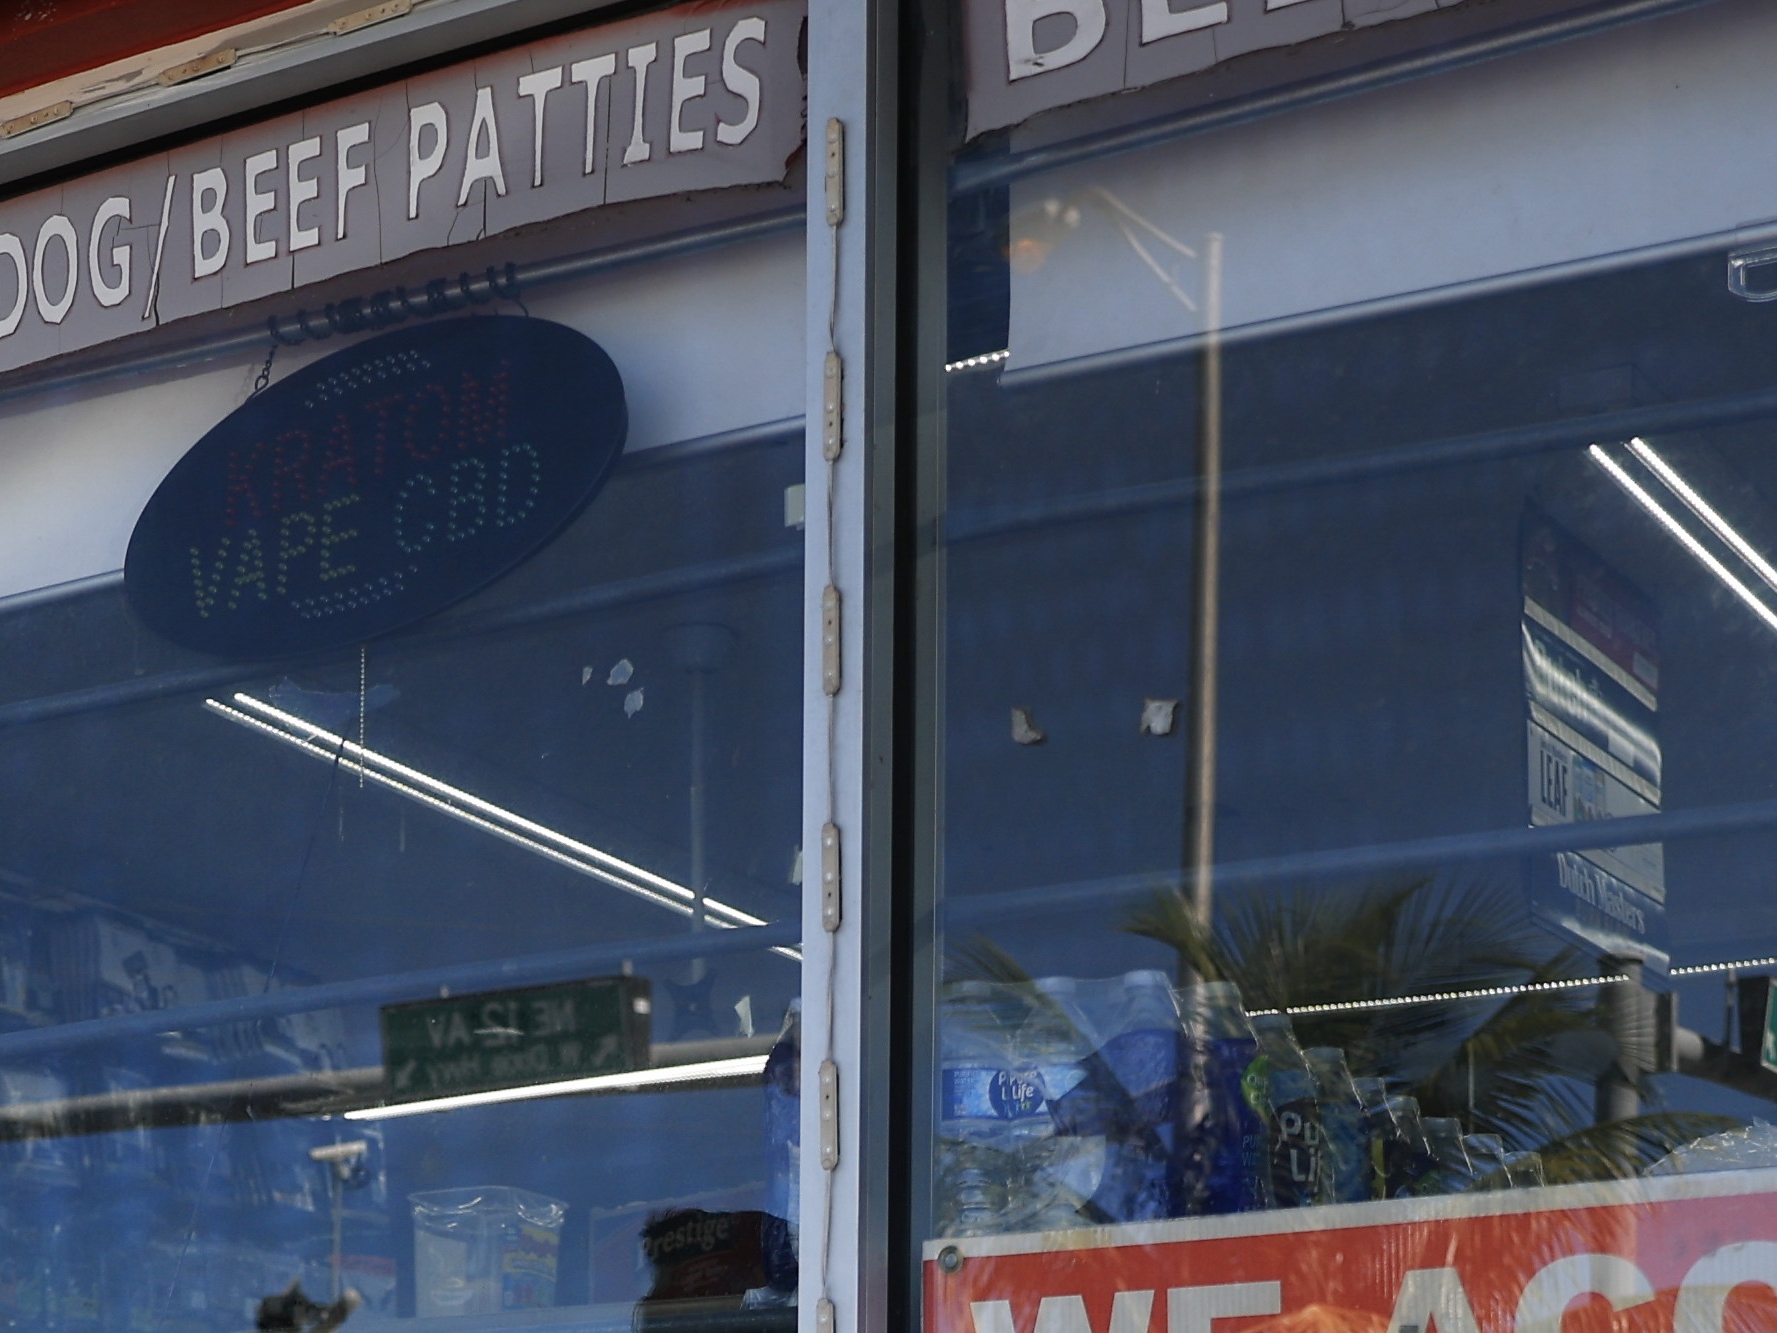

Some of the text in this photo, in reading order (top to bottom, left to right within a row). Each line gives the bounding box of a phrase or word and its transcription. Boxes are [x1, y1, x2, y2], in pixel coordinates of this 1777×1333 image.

[408, 15, 768, 221] PATTIES
[189, 440, 542, 620] VAPE CBD
[225, 356, 511, 528] KRATOM
